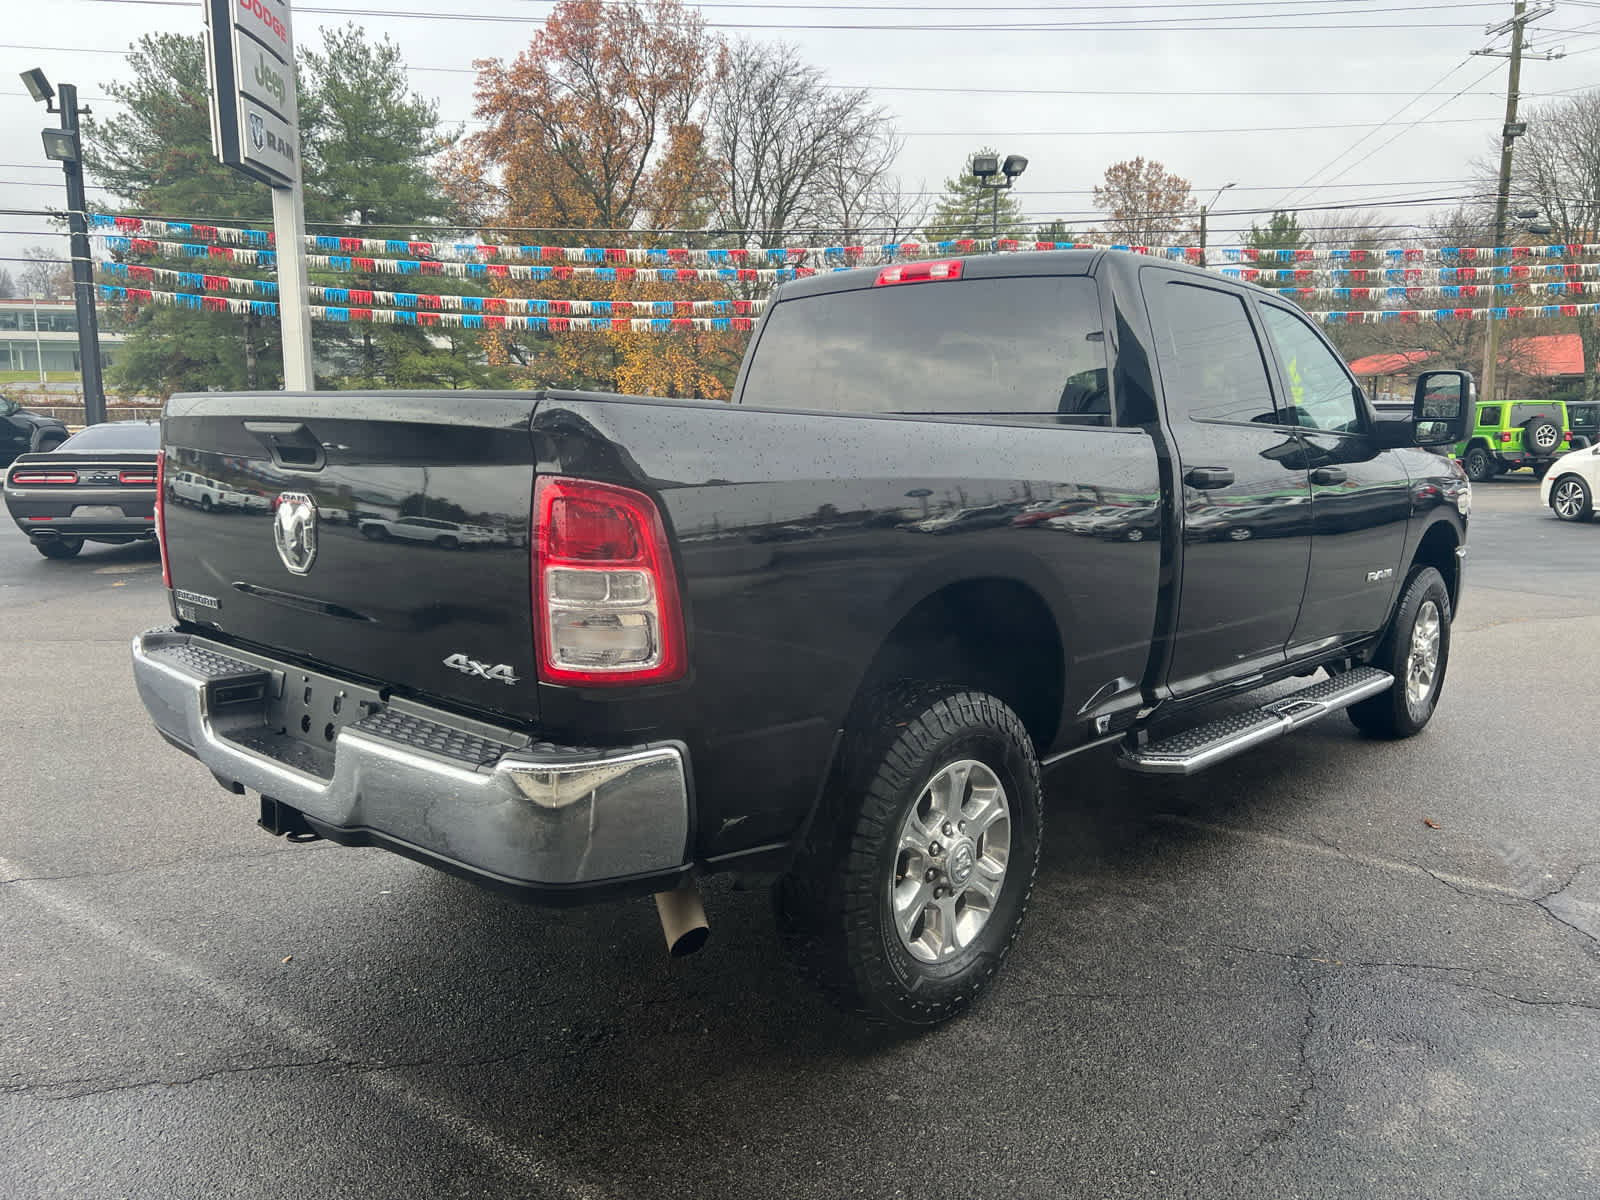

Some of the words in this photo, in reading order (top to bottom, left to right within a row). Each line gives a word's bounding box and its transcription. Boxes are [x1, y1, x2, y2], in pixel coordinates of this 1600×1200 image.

[254, 53, 286, 109] Jeep
[266, 130, 294, 162] RAM
[1367, 568, 1392, 582] RAM
